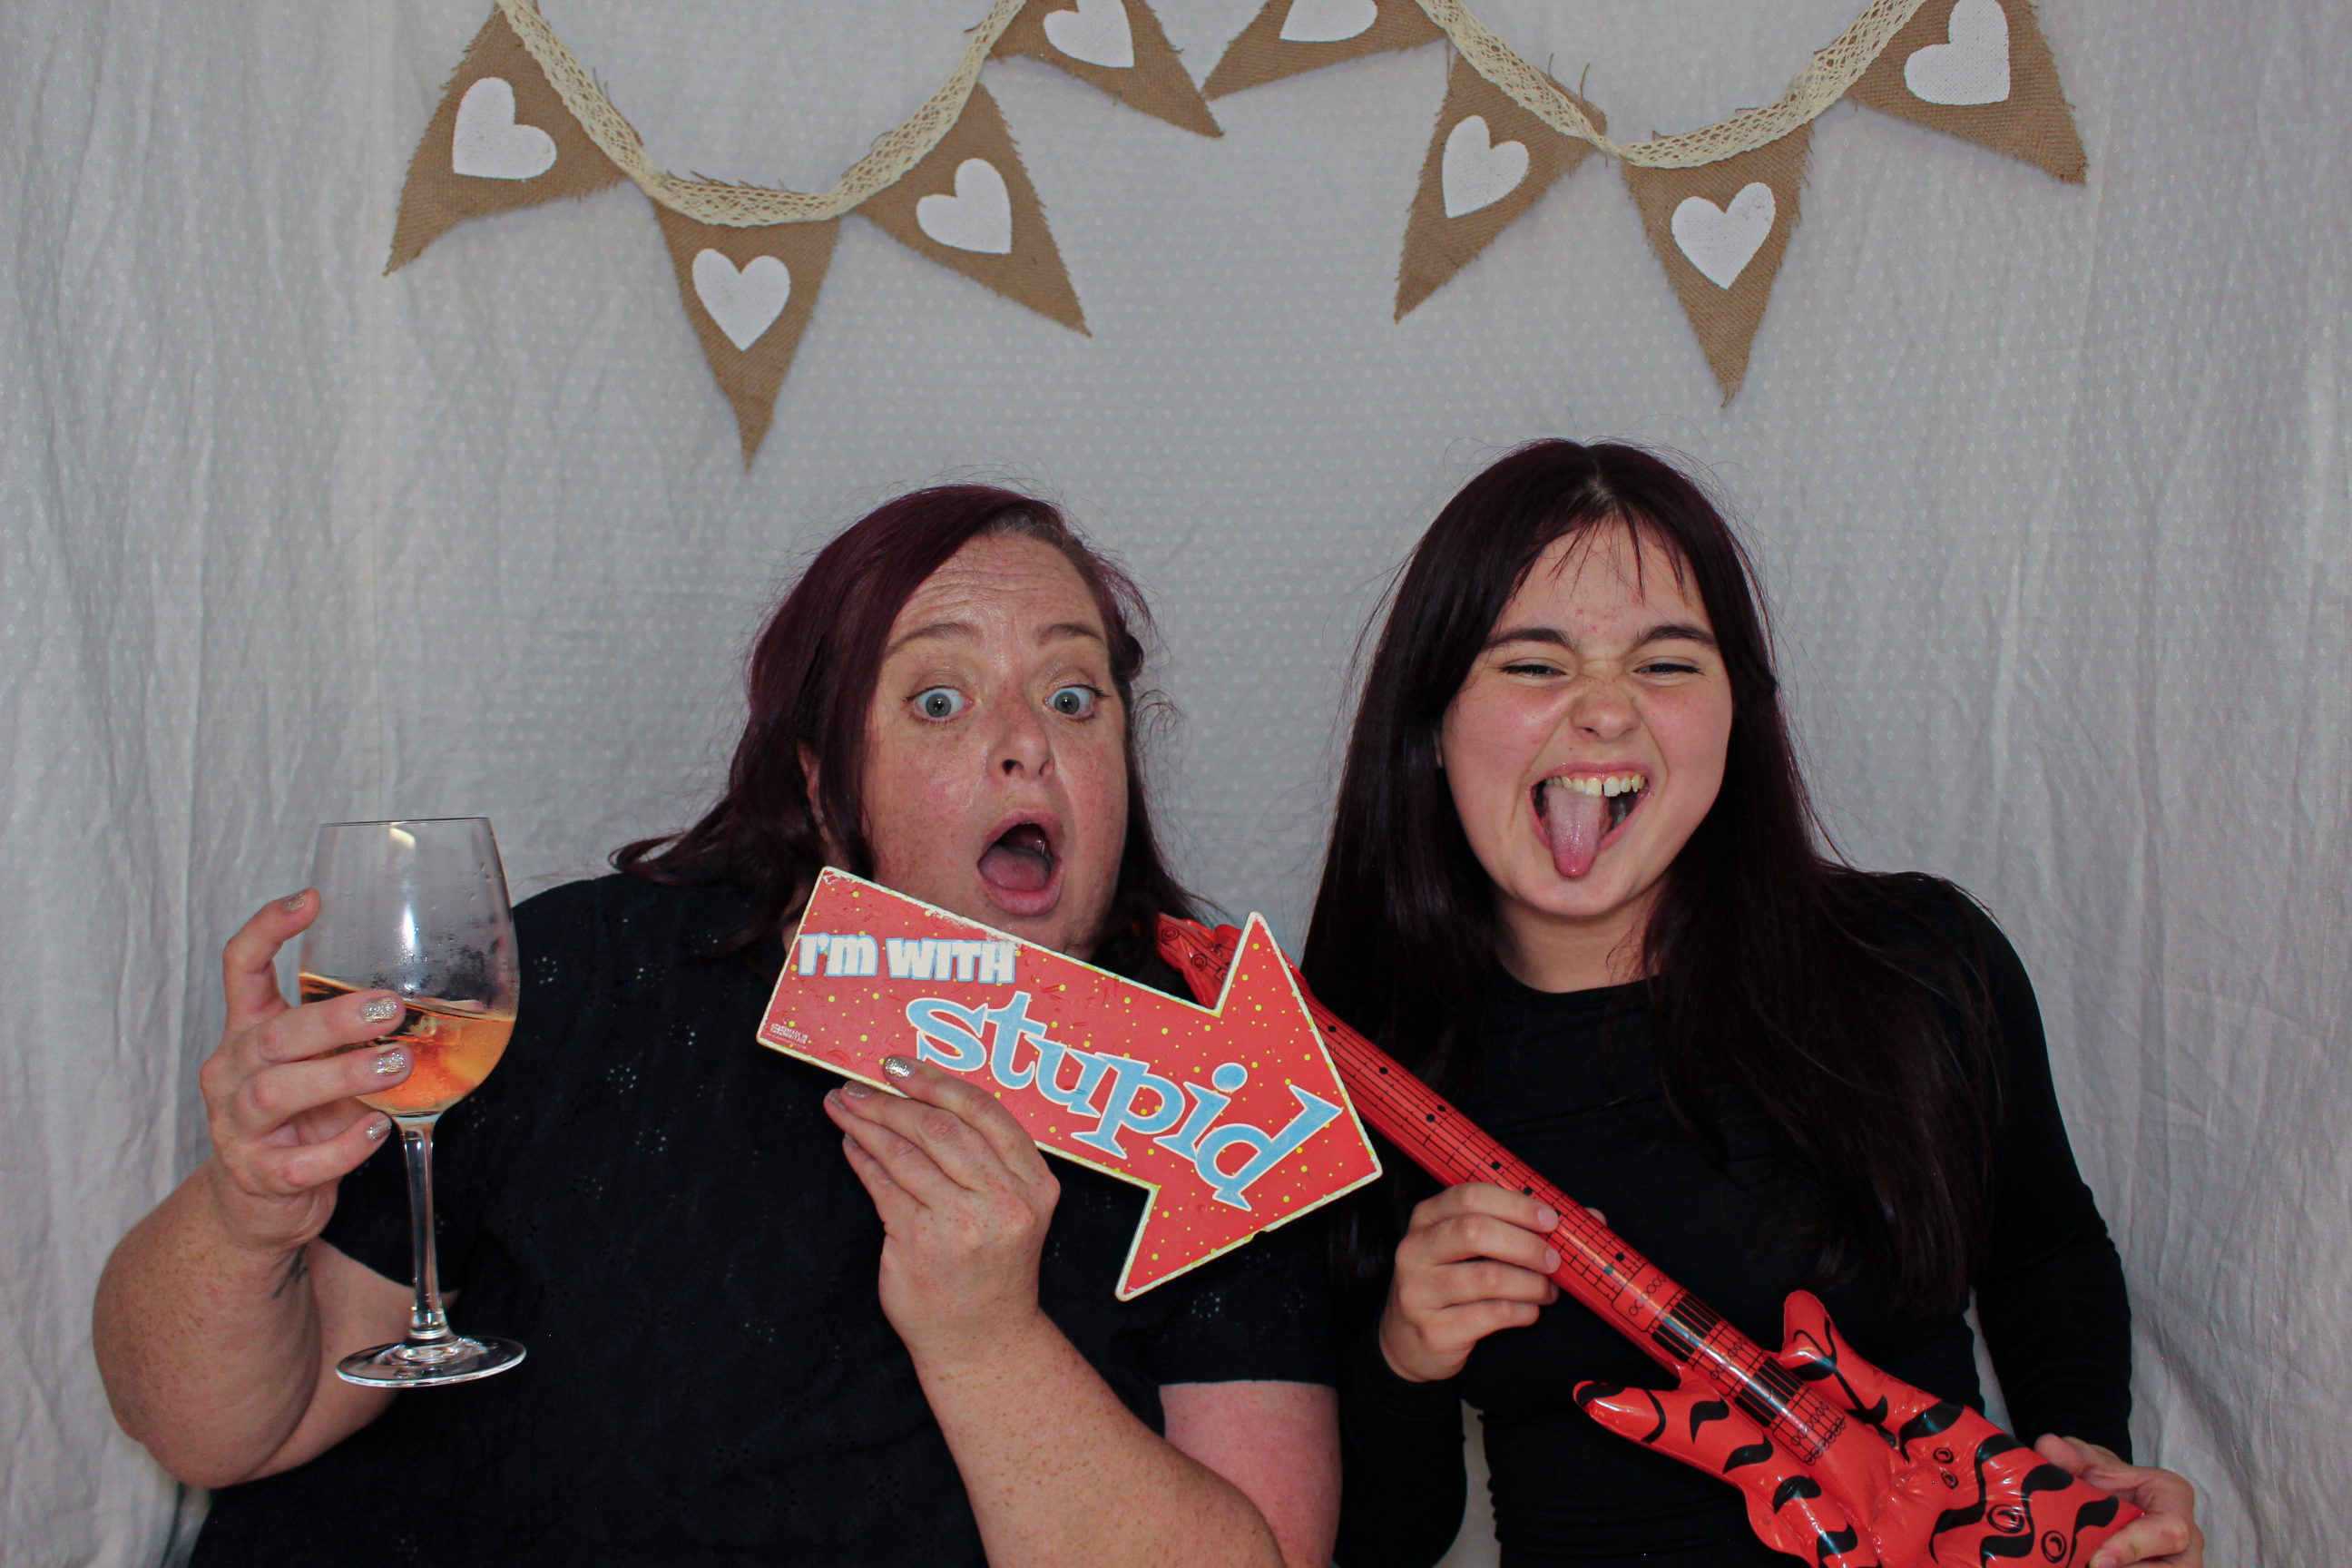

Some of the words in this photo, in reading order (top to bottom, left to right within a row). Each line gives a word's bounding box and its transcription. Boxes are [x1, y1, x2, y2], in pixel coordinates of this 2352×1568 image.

[886, 937, 1016, 984] WITH
[785, 1032, 807, 1044] BRITAIN
[787, 1027, 800, 1036] MADE
[906, 992, 1343, 1211] stupid
